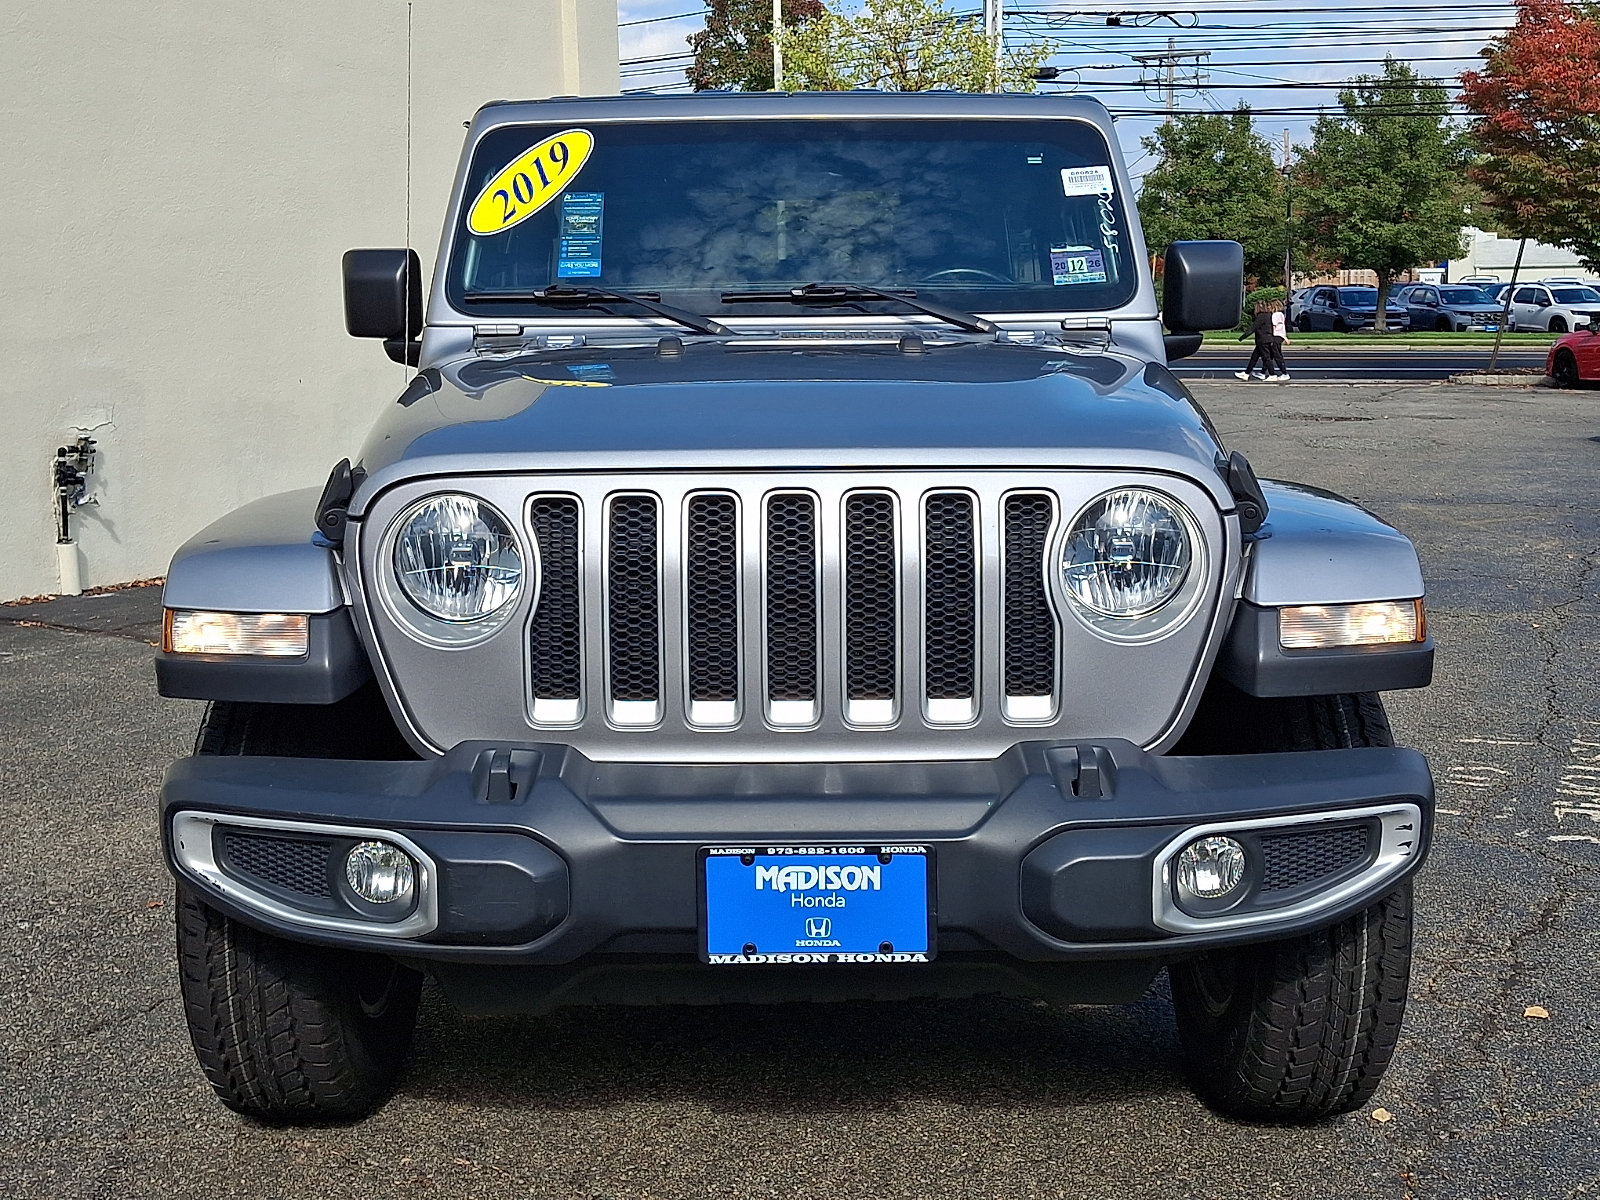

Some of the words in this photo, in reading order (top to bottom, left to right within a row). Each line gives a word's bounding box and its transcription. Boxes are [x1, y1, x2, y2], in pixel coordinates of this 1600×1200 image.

[493, 141, 569, 224] 2019
[1054, 262, 1066, 270] 20
[1070, 259, 1085, 272] 12
[880, 846, 927, 854] HONDA
[755, 865, 881, 893] MADISON
[791, 892, 846, 908] Honda
[708, 954, 829, 964] MADISON
[836, 953, 929, 963] HONDA
